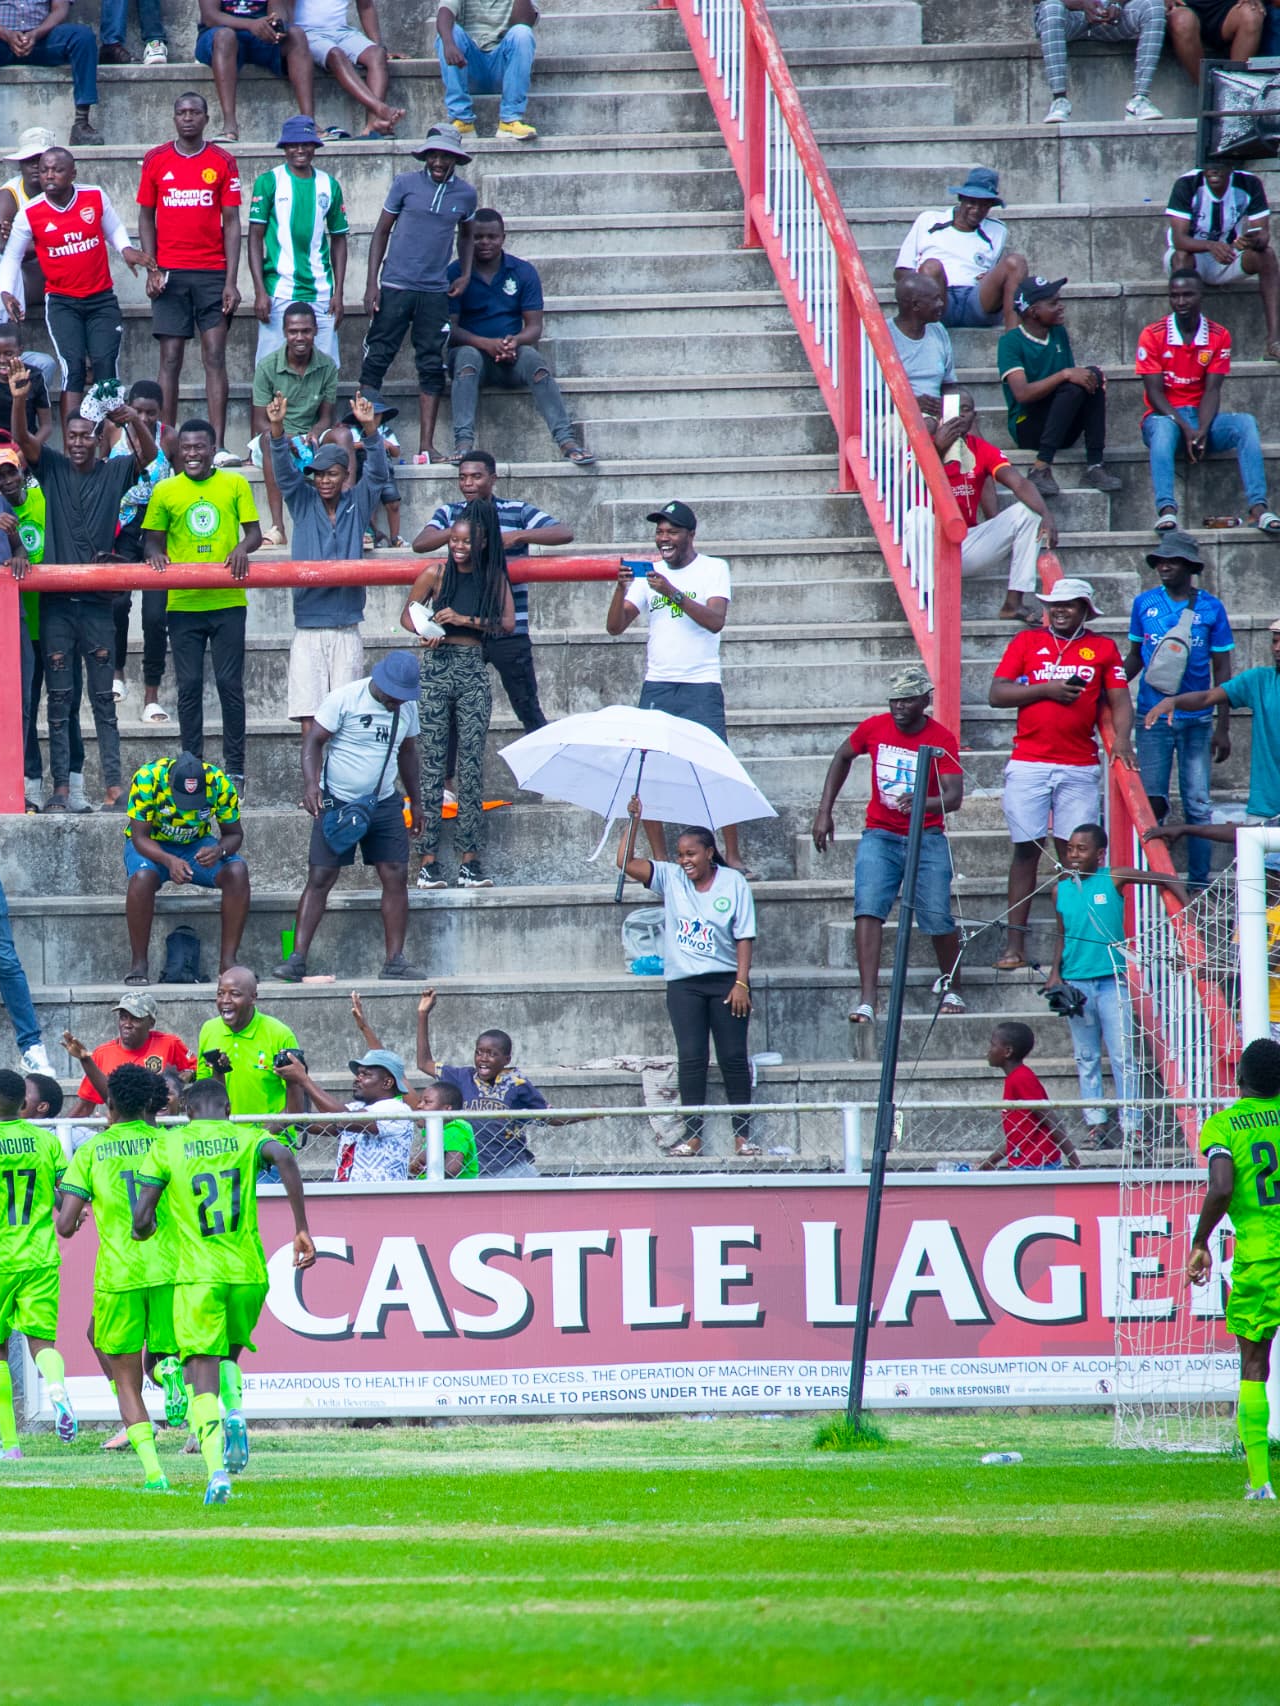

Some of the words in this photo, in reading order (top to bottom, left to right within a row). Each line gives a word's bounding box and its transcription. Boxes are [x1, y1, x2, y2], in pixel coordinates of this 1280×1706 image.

[163, 196, 200, 207] Viewer
[168, 188, 200, 199] Team
[47, 236, 100, 258] Emirates
[63, 231, 83, 243] Fly
[1042, 661, 1077, 673] Team
[677, 934, 713, 952] MWOS
[95, 1137, 158, 1162] CHIKWEN
[184, 1136, 239, 1161] MASAZA
[2, 1168, 37, 1227] 17
[191, 1167, 241, 1238] 27
[267, 1225, 764, 1341] CASTLE
[260, 1376, 341, 1390] HAZARDOUS
[343, 1376, 363, 1389] TO
[365, 1375, 416, 1388] HEALTH
[418, 1375, 430, 1387] IF
[433, 1373, 509, 1388] CONSUMED
[512, 1373, 530, 1386] TO
[593, 1369, 617, 1382] THE
[620, 1366, 695, 1381] OPERATION
[698, 1365, 717, 1379] OF
[718, 1364, 800, 1378] MACHINERY
[800, 1364, 819, 1377] OR
[821, 1364, 873, 1377] DRIVG
[876, 1363, 918, 1376] AFTER
[922, 1362, 948, 1375] THE
[950, 1359, 1049, 1376] CONSUMPTION
[1052, 1360, 1070, 1374] OF
[1072, 1358, 1135, 1373] ALCOHOL
[1154, 1359, 1181, 1372] NOT
[521, 1392, 555, 1405] SALE
[560, 1391, 578, 1403] TO
[582, 1389, 647, 1402] PERSONS
[651, 1387, 698, 1400] UNDER
[701, 1386, 728, 1398] THE
[731, 1385, 760, 1398] AGE
[764, 1385, 783, 1397] OF
[787, 1385, 802, 1398] 18
[804, 1385, 849, 1398] YEARS
[929, 1386, 955, 1396] DRINK
[957, 1384, 1011, 1396] RESPONSIBLY
